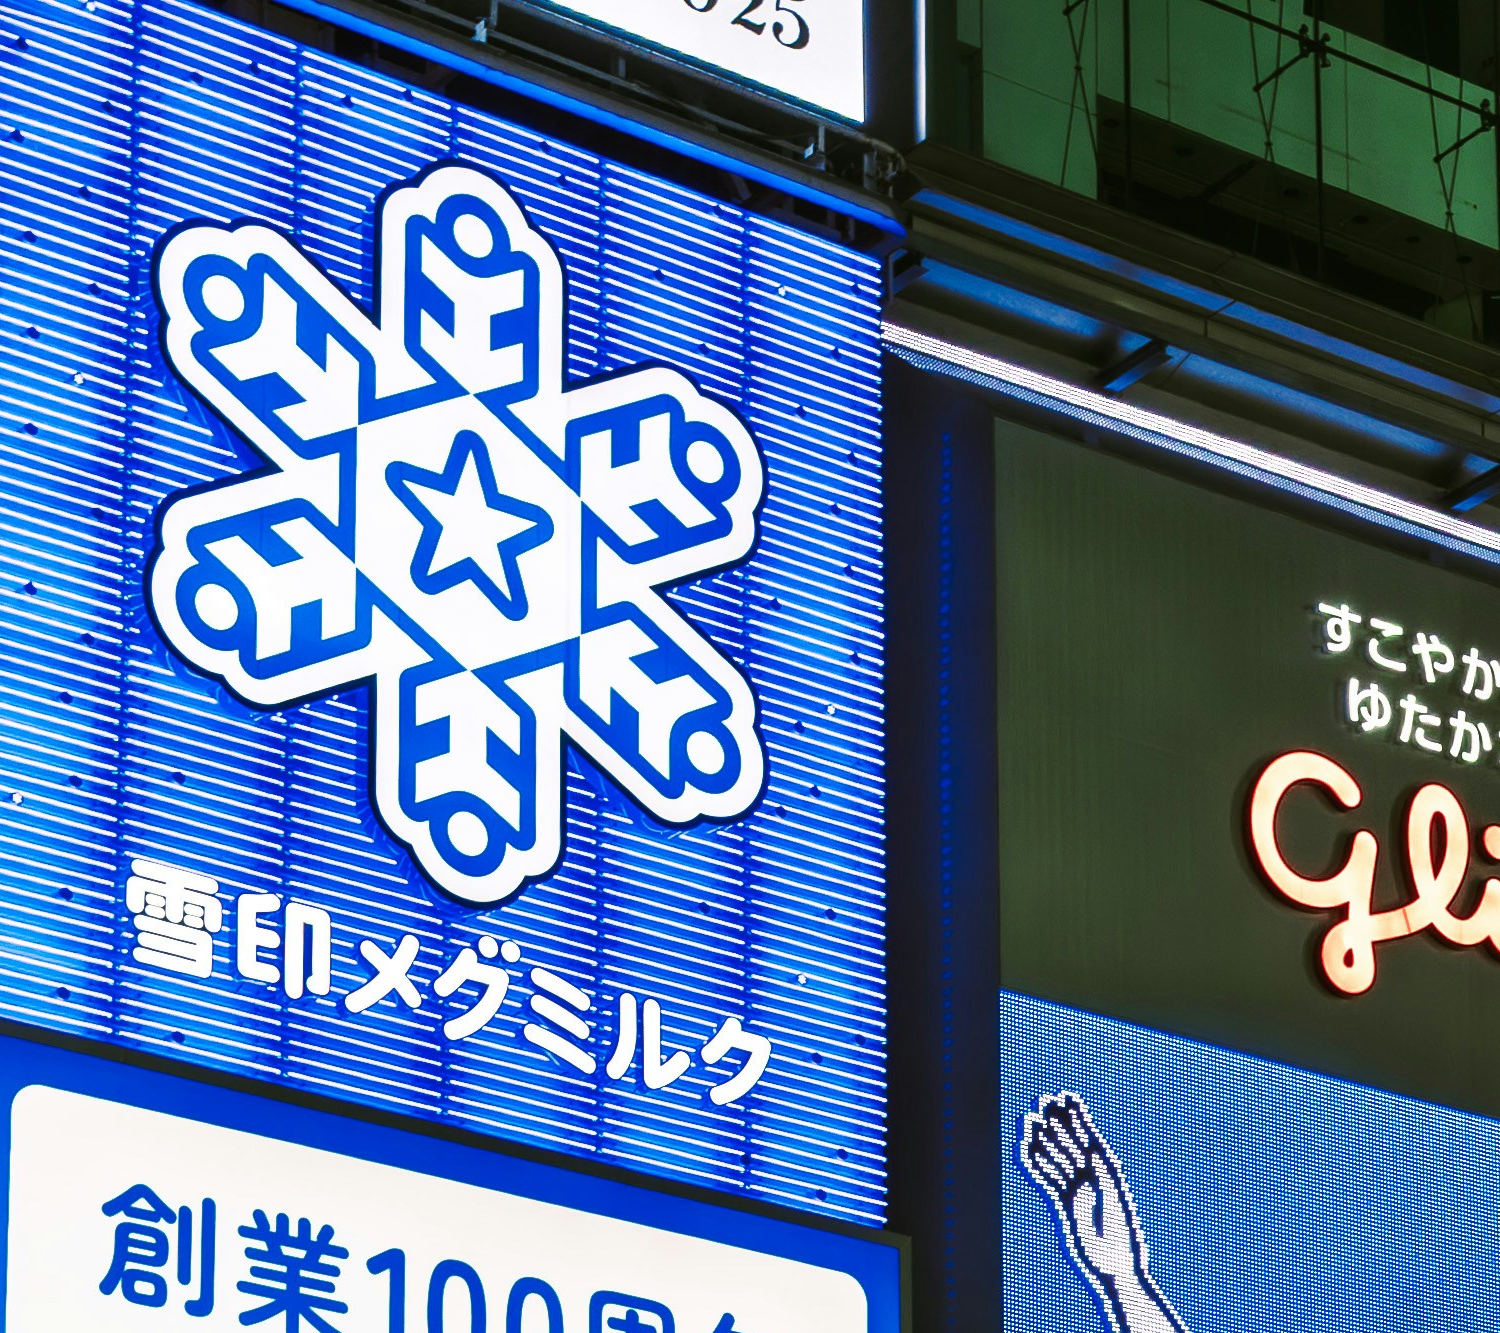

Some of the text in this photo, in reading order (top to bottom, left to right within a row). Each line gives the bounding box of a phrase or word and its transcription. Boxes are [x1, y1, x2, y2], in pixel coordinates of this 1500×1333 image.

[124, 855, 777, 1110] 雪印メグミルク
